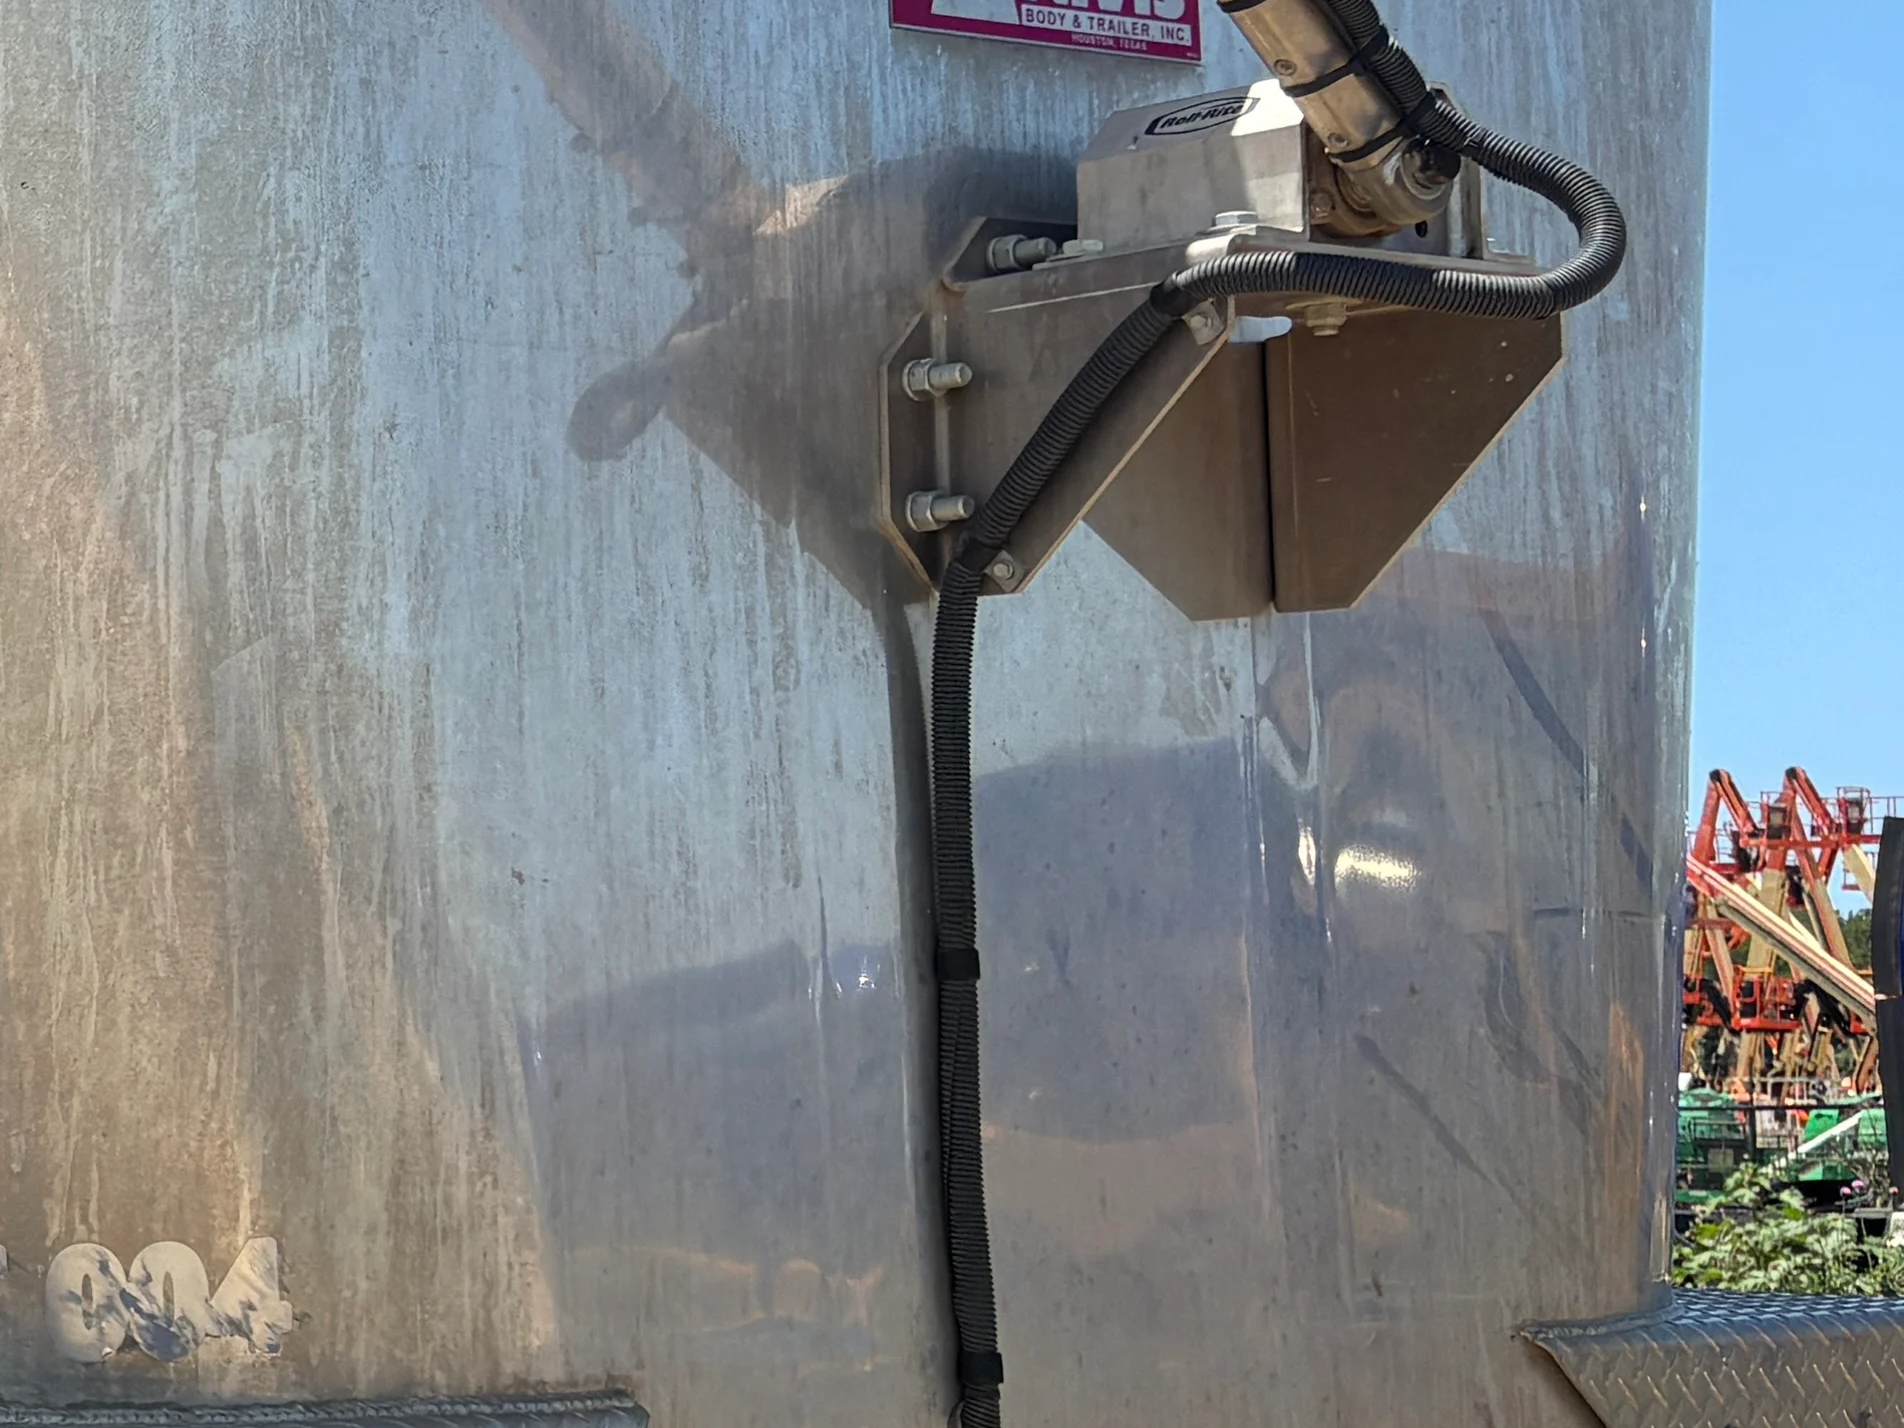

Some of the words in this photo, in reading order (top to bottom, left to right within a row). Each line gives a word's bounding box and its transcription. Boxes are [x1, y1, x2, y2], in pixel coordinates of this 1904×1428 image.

[1025, 8, 1066, 26] BODY
[1072, 14, 1082, 29] &
[1087, 16, 1155, 39] TRAILER,
[1161, 25, 1190, 42] INC.
